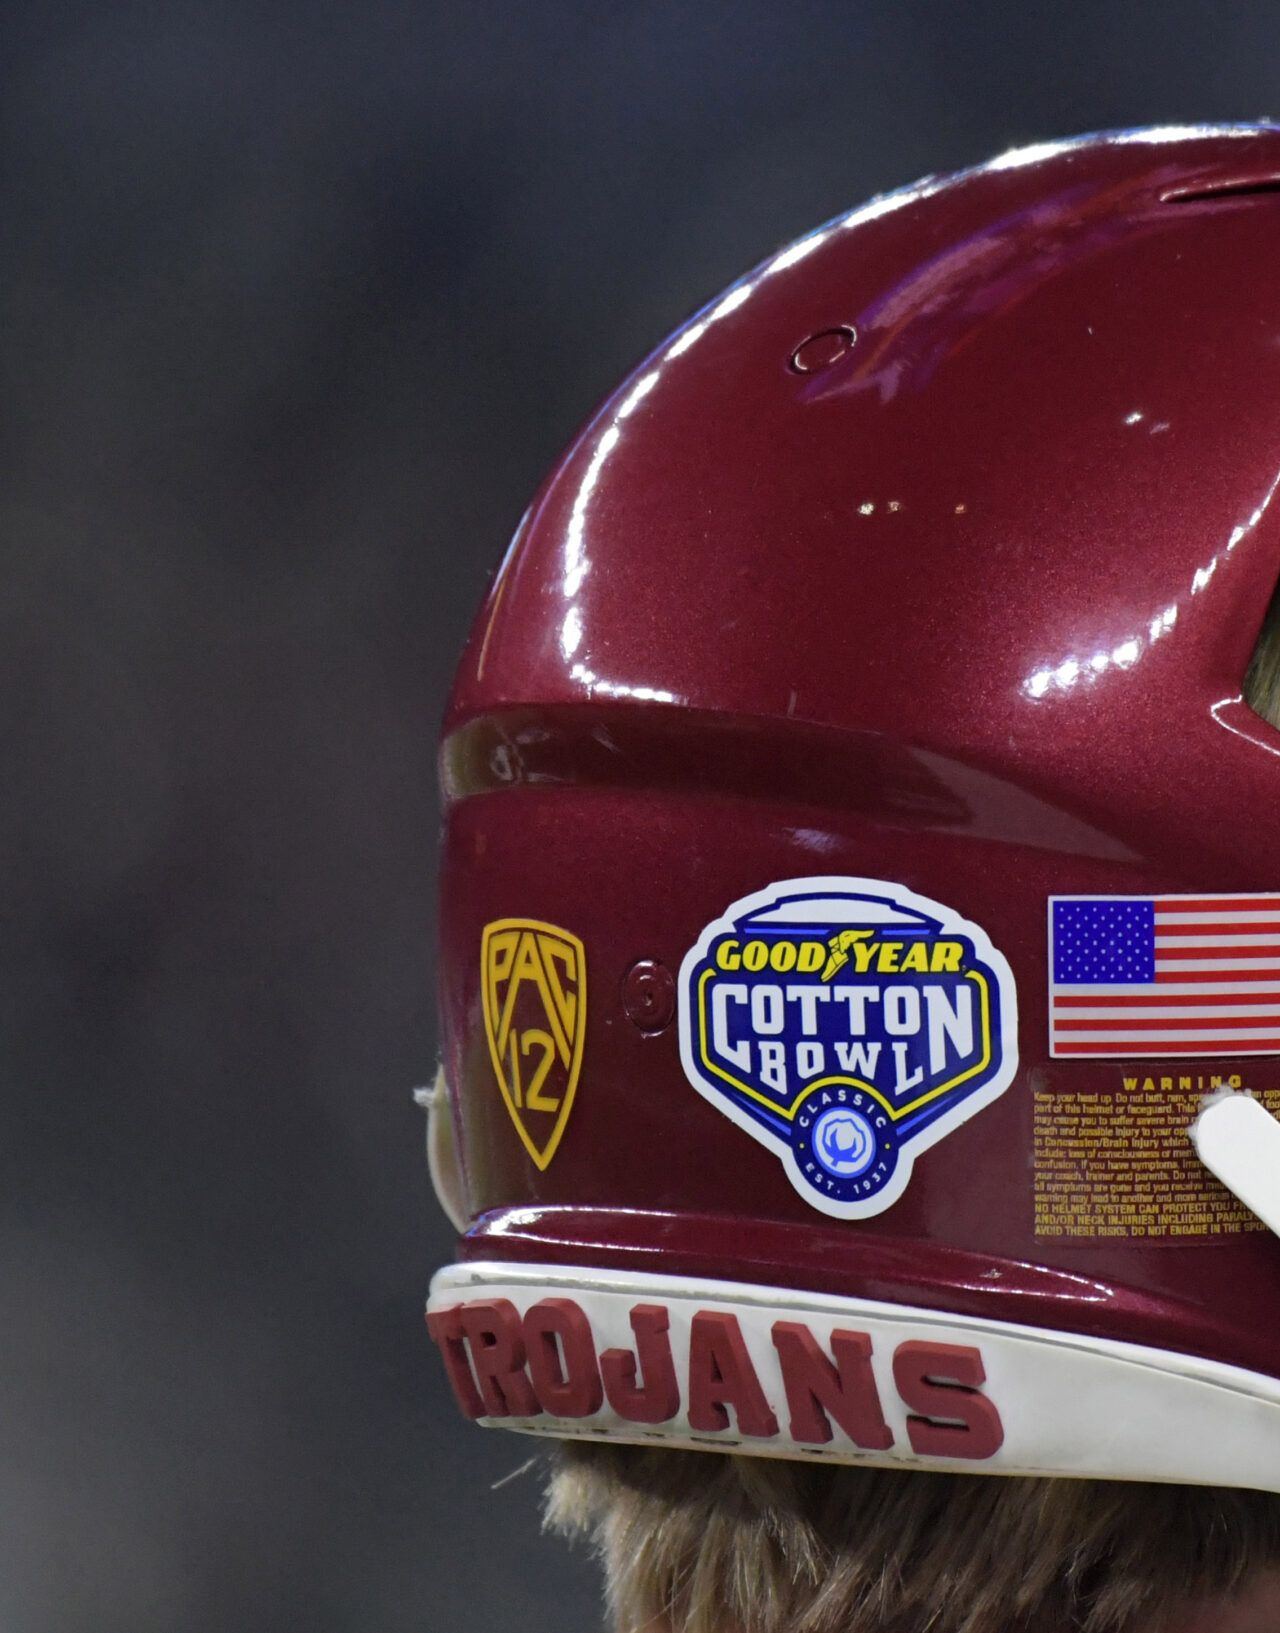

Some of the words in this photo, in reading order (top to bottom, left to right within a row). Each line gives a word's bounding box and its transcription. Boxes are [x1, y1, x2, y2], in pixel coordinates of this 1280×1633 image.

[488, 931, 577, 1072] PAC
[711, 983, 974, 1075] COTTON
[509, 1028, 560, 1112] 12
[758, 1041, 924, 1096] BOWL
[1123, 1075, 1241, 1091] WARNING
[1056, 1095, 1076, 1104] your
[1077, 1093, 1098, 1103] head
[1115, 1093, 1128, 1103] Do
[1129, 1094, 1144, 1103] not
[799, 1089, 887, 1128] CLASSIC
[1034, 1104, 1051, 1114] part
[1053, 1104, 1063, 1113] of
[1064, 1104, 1081, 1114] this
[1082, 1104, 1113, 1114] helmet
[1115, 1106, 1125, 1114] or
[1176, 1103, 1196, 1113] This
[1034, 1116, 1052, 1126] may
[1053, 1117, 1079, 1126] cause
[1080, 1118, 1097, 1127] you
[1098, 1116, 1107, 1126] to
[1109, 1116, 1134, 1126] suffer
[1136, 1118, 1165, 1126] severe
[1167, 1116, 1189, 1125] brain
[1033, 1126, 1058, 1136] death
[1059, 1127, 1076, 1136] and
[1078, 1127, 1114, 1137] possible
[1141, 1126, 1151, 1136] to
[1152, 1128, 1172, 1138] your
[1161, 1137, 1189, 1147] which
[1068, 1149, 1086, 1159] loss
[1087, 1148, 1096, 1158] of
[1161, 1150, 1171, 1158] or
[1089, 1162, 1105, 1171] you
[1107, 1160, 1130, 1170] have
[853, 1162, 887, 1194] 1937
[1034, 1172, 1053, 1182] your
[1085, 1171, 1114, 1181] trainer
[1116, 1172, 1133, 1182] and
[1173, 1171, 1186, 1180] Do
[1187, 1170, 1202, 1180] not
[1046, 1182, 1092, 1193] symptoms
[1134, 1182, 1151, 1192] and
[1152, 1184, 1169, 1193] you
[1171, 1182, 1204, 1191] receive
[1034, 1194, 1069, 1204] warning
[1070, 1195, 1089, 1205] may
[1110, 1194, 1120, 1203] to
[1121, 1194, 1154, 1203] another
[1155, 1192, 1172, 1202] and
[1174, 1194, 1197, 1202] more
[1034, 1204, 1049, 1214] NO
[1051, 1204, 1091, 1214] HELMET
[1094, 1204, 1136, 1214] SYSTEM
[1138, 1204, 1160, 1214] CAN
[1162, 1202, 1207, 1214] PROTECT
[1209, 1202, 1230, 1213] YOU
[1034, 1215, 1075, 1225] AND/OR
[1077, 1215, 1105, 1225] NECK
[1107, 1215, 1155, 1225] INJURIES
[1157, 1213, 1214, 1225] INCLUDING
[1034, 1226, 1063, 1236] AVOID
[1064, 1226, 1096, 1237] THESE
[1131, 1226, 1146, 1236] DO
[1147, 1225, 1168, 1236] NOT
[1169, 1224, 1208, 1235] ENGAGE
[1210, 1223, 1220, 1234] IN
[1222, 1222, 1242, 1233] THE
[425, 1297, 1004, 1460] TROJANS
